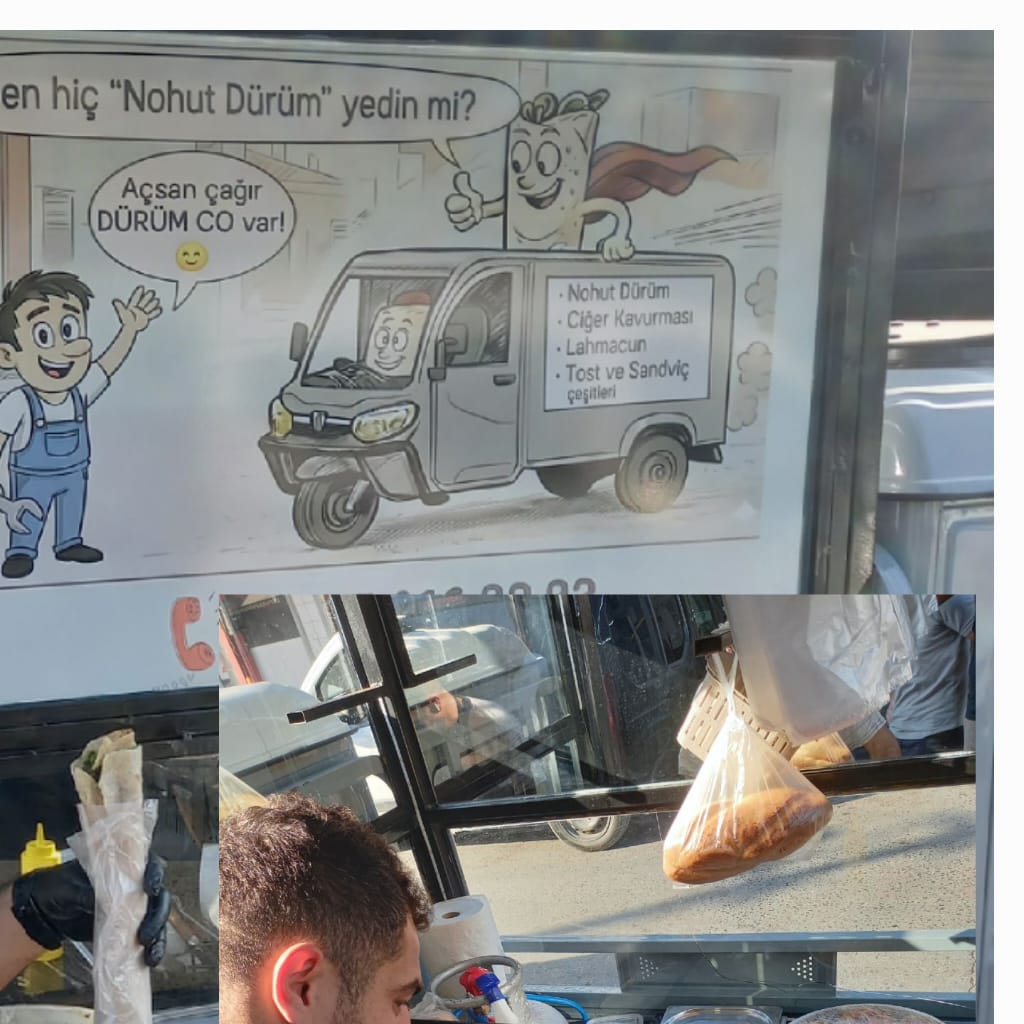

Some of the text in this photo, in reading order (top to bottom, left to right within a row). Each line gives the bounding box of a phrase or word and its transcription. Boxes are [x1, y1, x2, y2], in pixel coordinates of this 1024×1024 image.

[52, 76, 99, 121] hiç
[110, 79, 215, 114] “Nohut
[226, 82, 332, 117] Dürüm”
[342, 87, 418, 127] yedin
[428, 89, 476, 121] mi?
[121, 177, 263, 206] Açsan çağır
[98, 205, 285, 232] DÜRÜM CO var!
[568, 282, 670, 301] Nohut Dürüm
[567, 309, 693, 333] Ciğer Kavurması
[566, 336, 647, 356] Lahmacun
[566, 360, 689, 382] Tost ve Sandviç
[568, 385, 616, 405] çeşitleri
